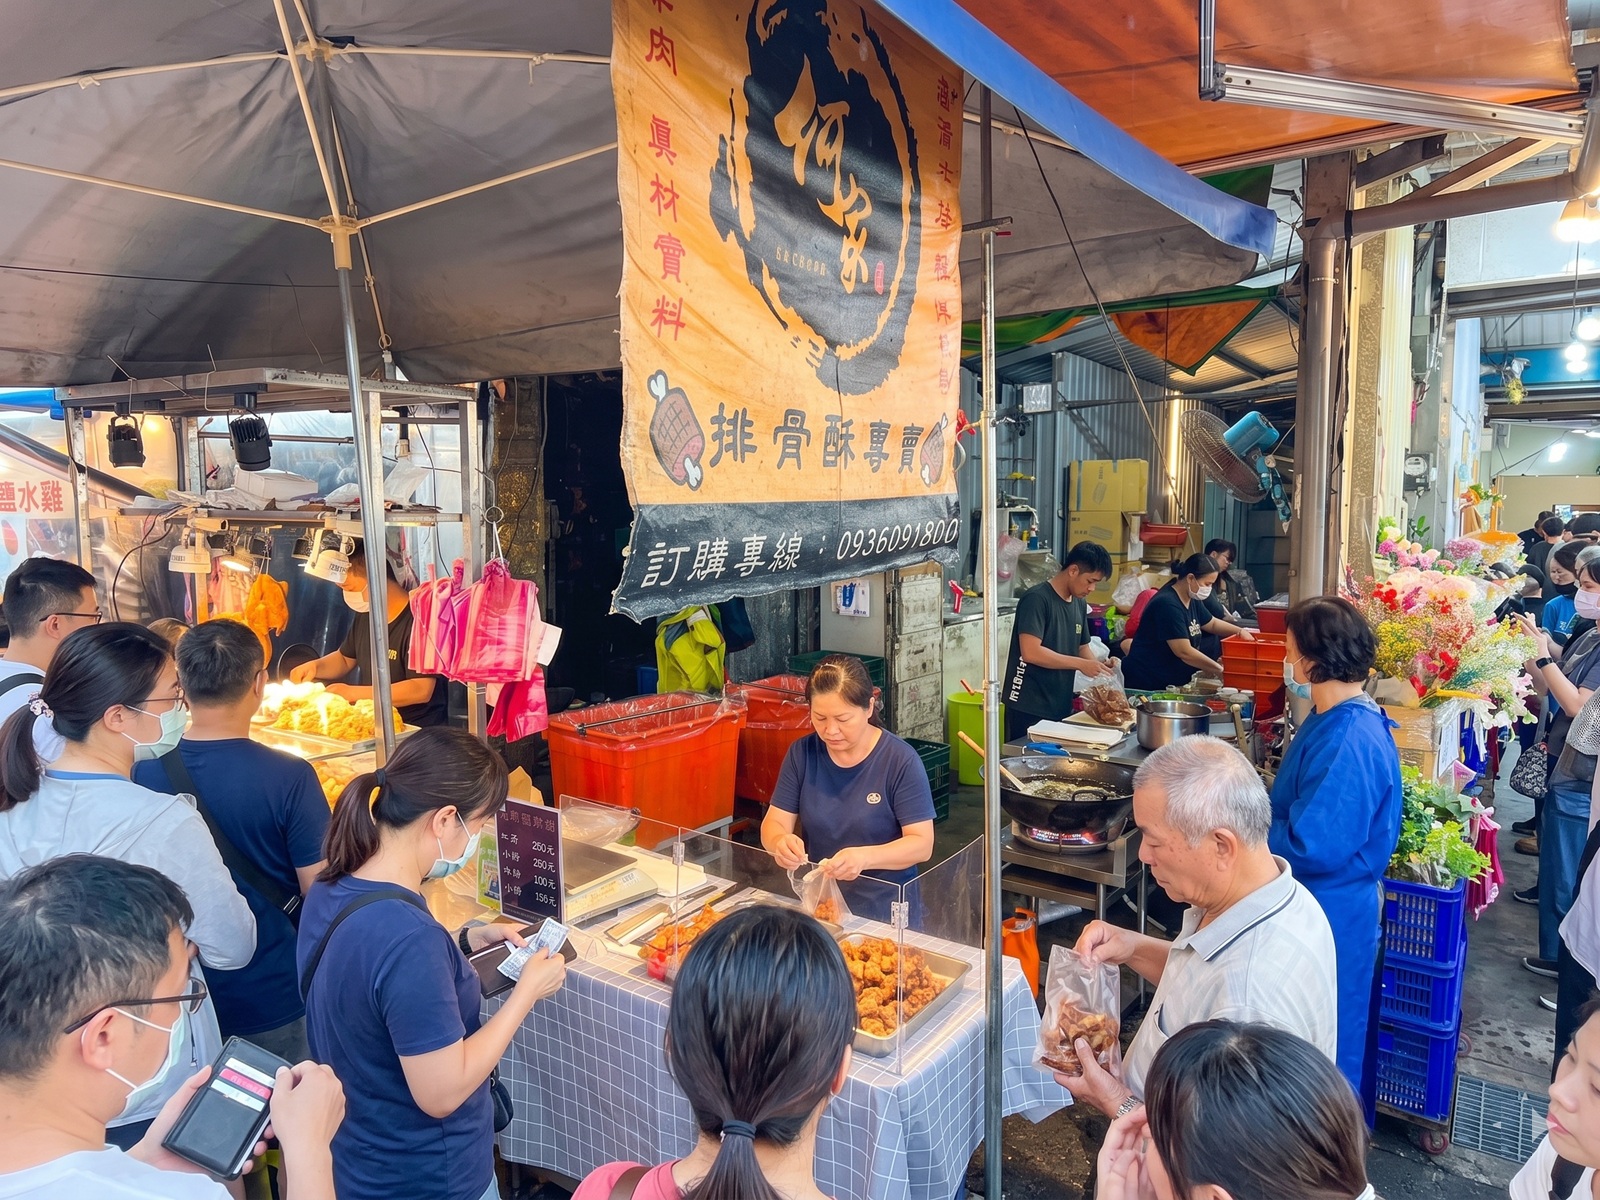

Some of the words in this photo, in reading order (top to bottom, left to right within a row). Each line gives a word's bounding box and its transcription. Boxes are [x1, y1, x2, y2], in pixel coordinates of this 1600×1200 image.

[709, 402, 925, 474] 排骨酥專賣
